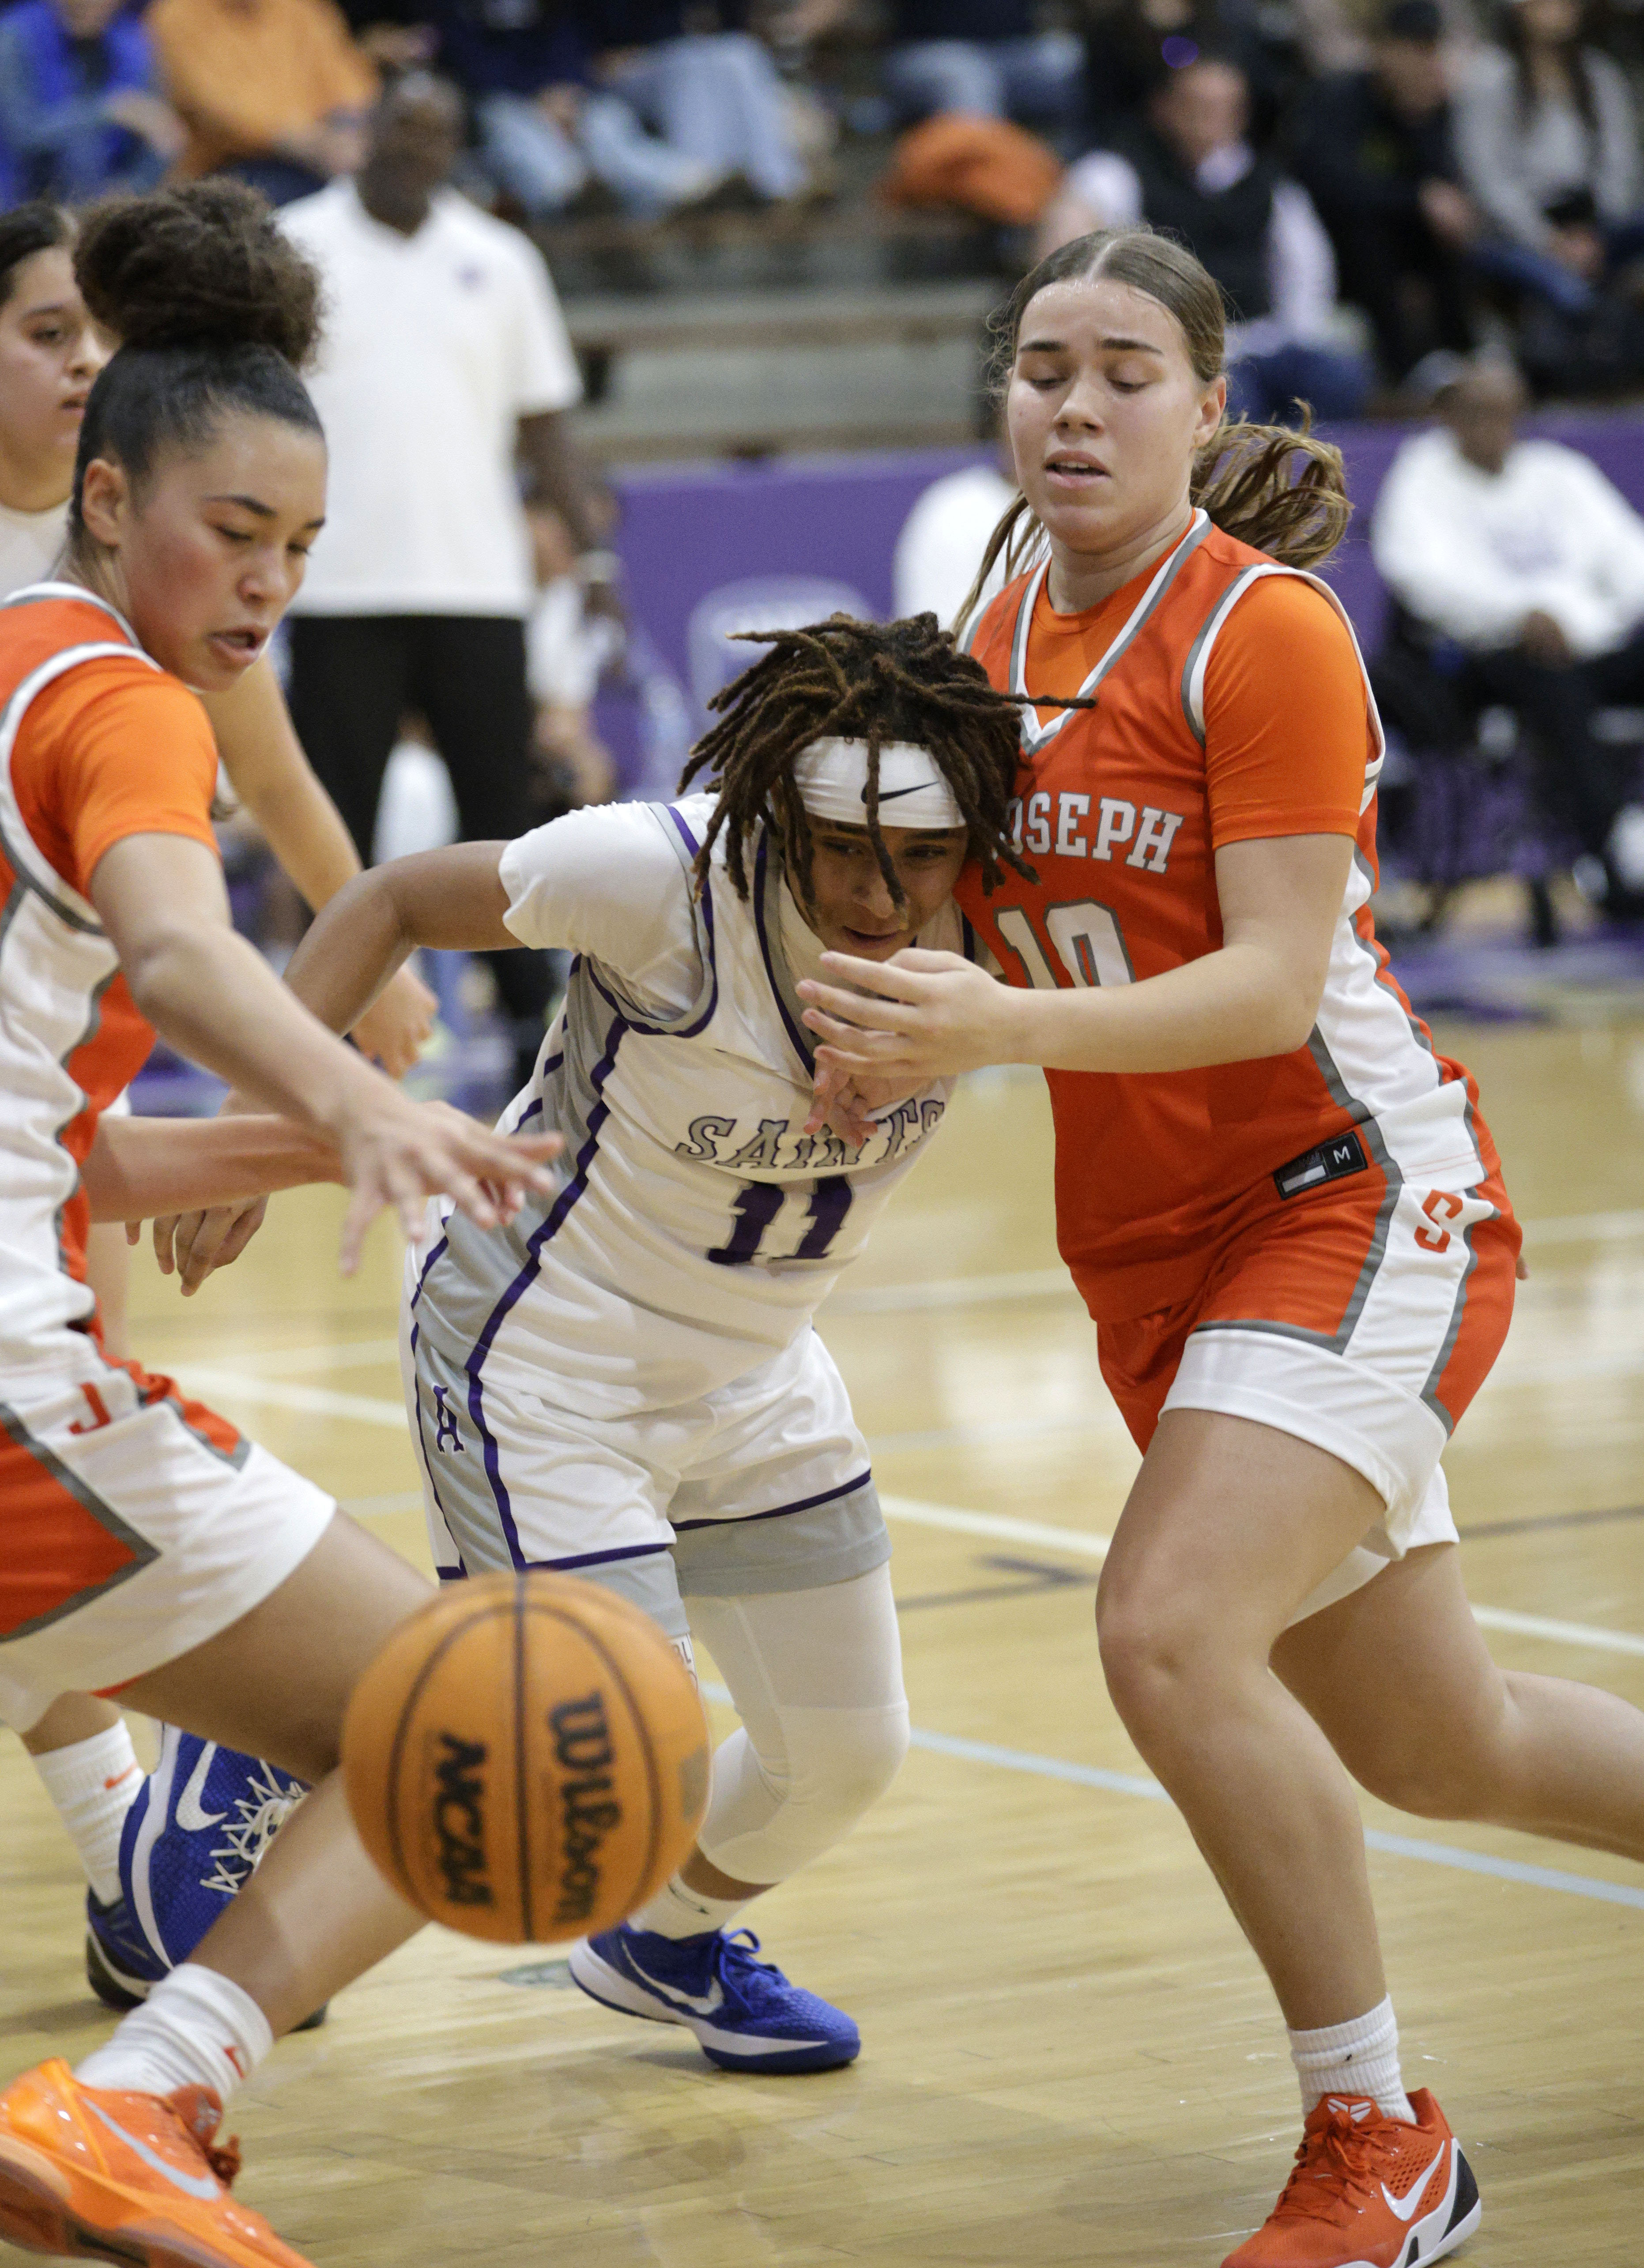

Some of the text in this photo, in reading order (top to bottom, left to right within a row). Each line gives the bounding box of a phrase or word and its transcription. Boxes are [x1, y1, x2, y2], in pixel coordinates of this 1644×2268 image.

[991, 791, 1185, 875] OSEPH
[992, 897, 1137, 989] 10
[1333, 1145, 1351, 1164] M
[707, 1173, 856, 1266] 11
[547, 1686, 623, 1926] Wilson
